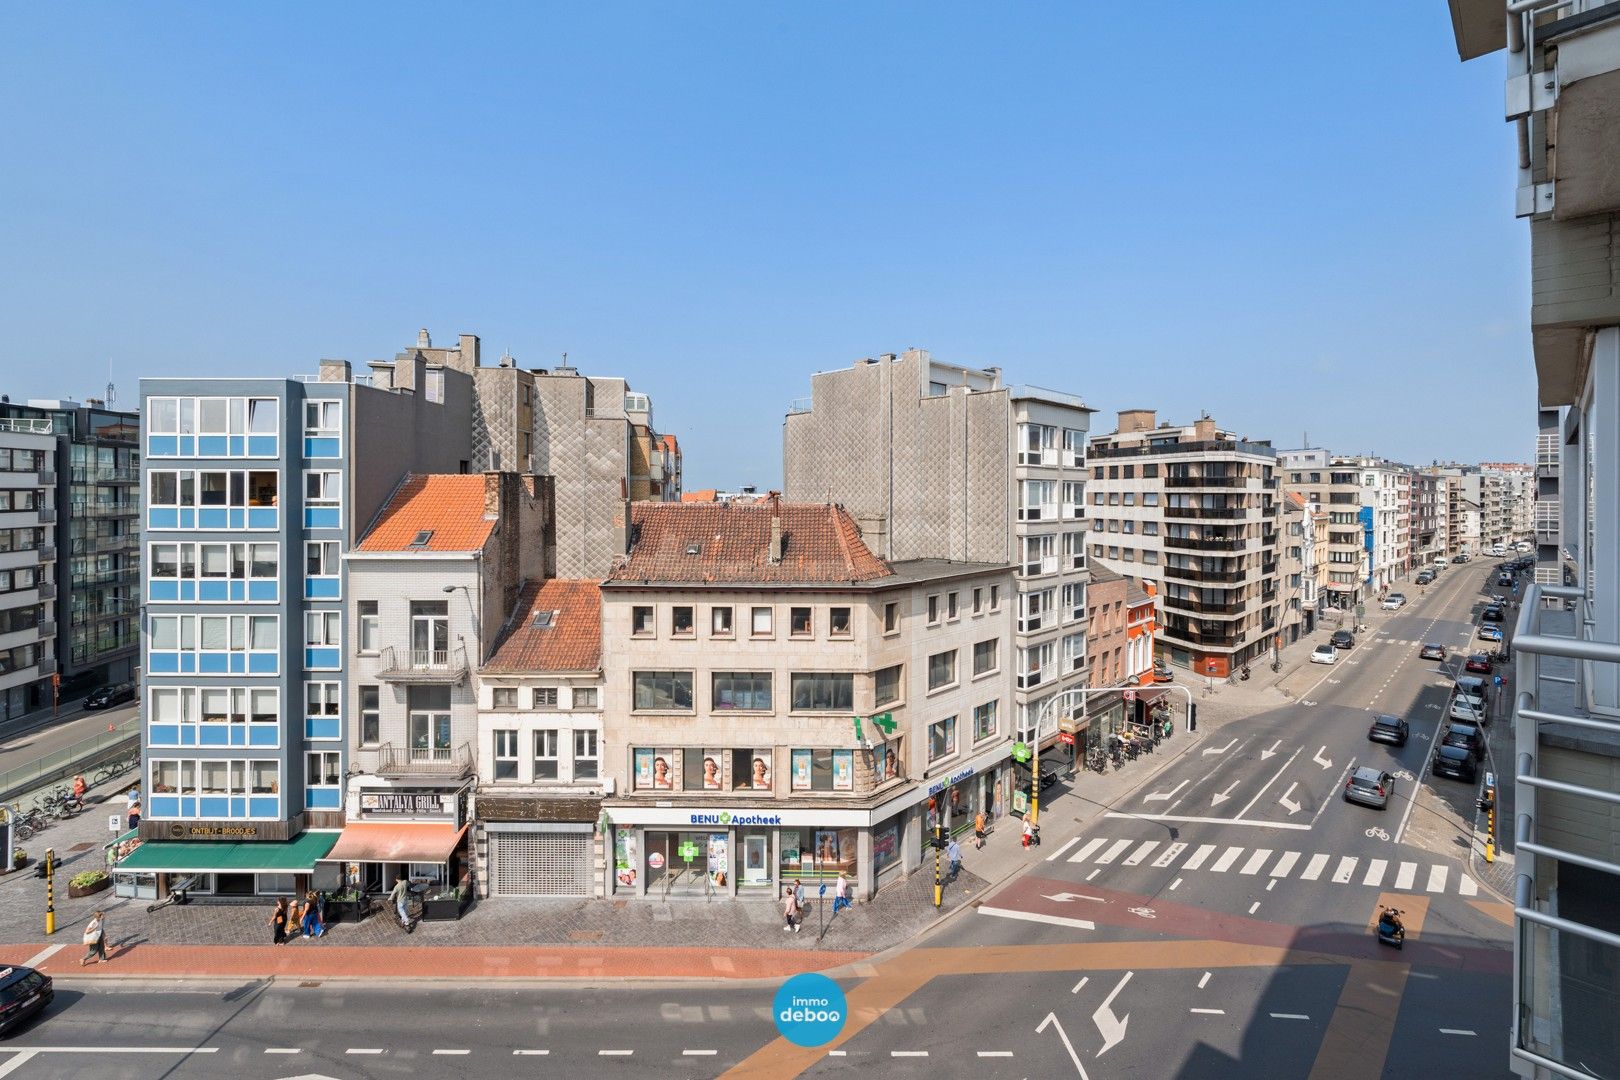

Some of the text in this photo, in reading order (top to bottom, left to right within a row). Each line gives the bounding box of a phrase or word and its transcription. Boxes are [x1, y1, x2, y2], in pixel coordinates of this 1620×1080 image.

[378, 795, 413, 809] ANTALYA
[415, 795, 440, 809] GRILL
[690, 814, 782, 826] BENU Apotheek
